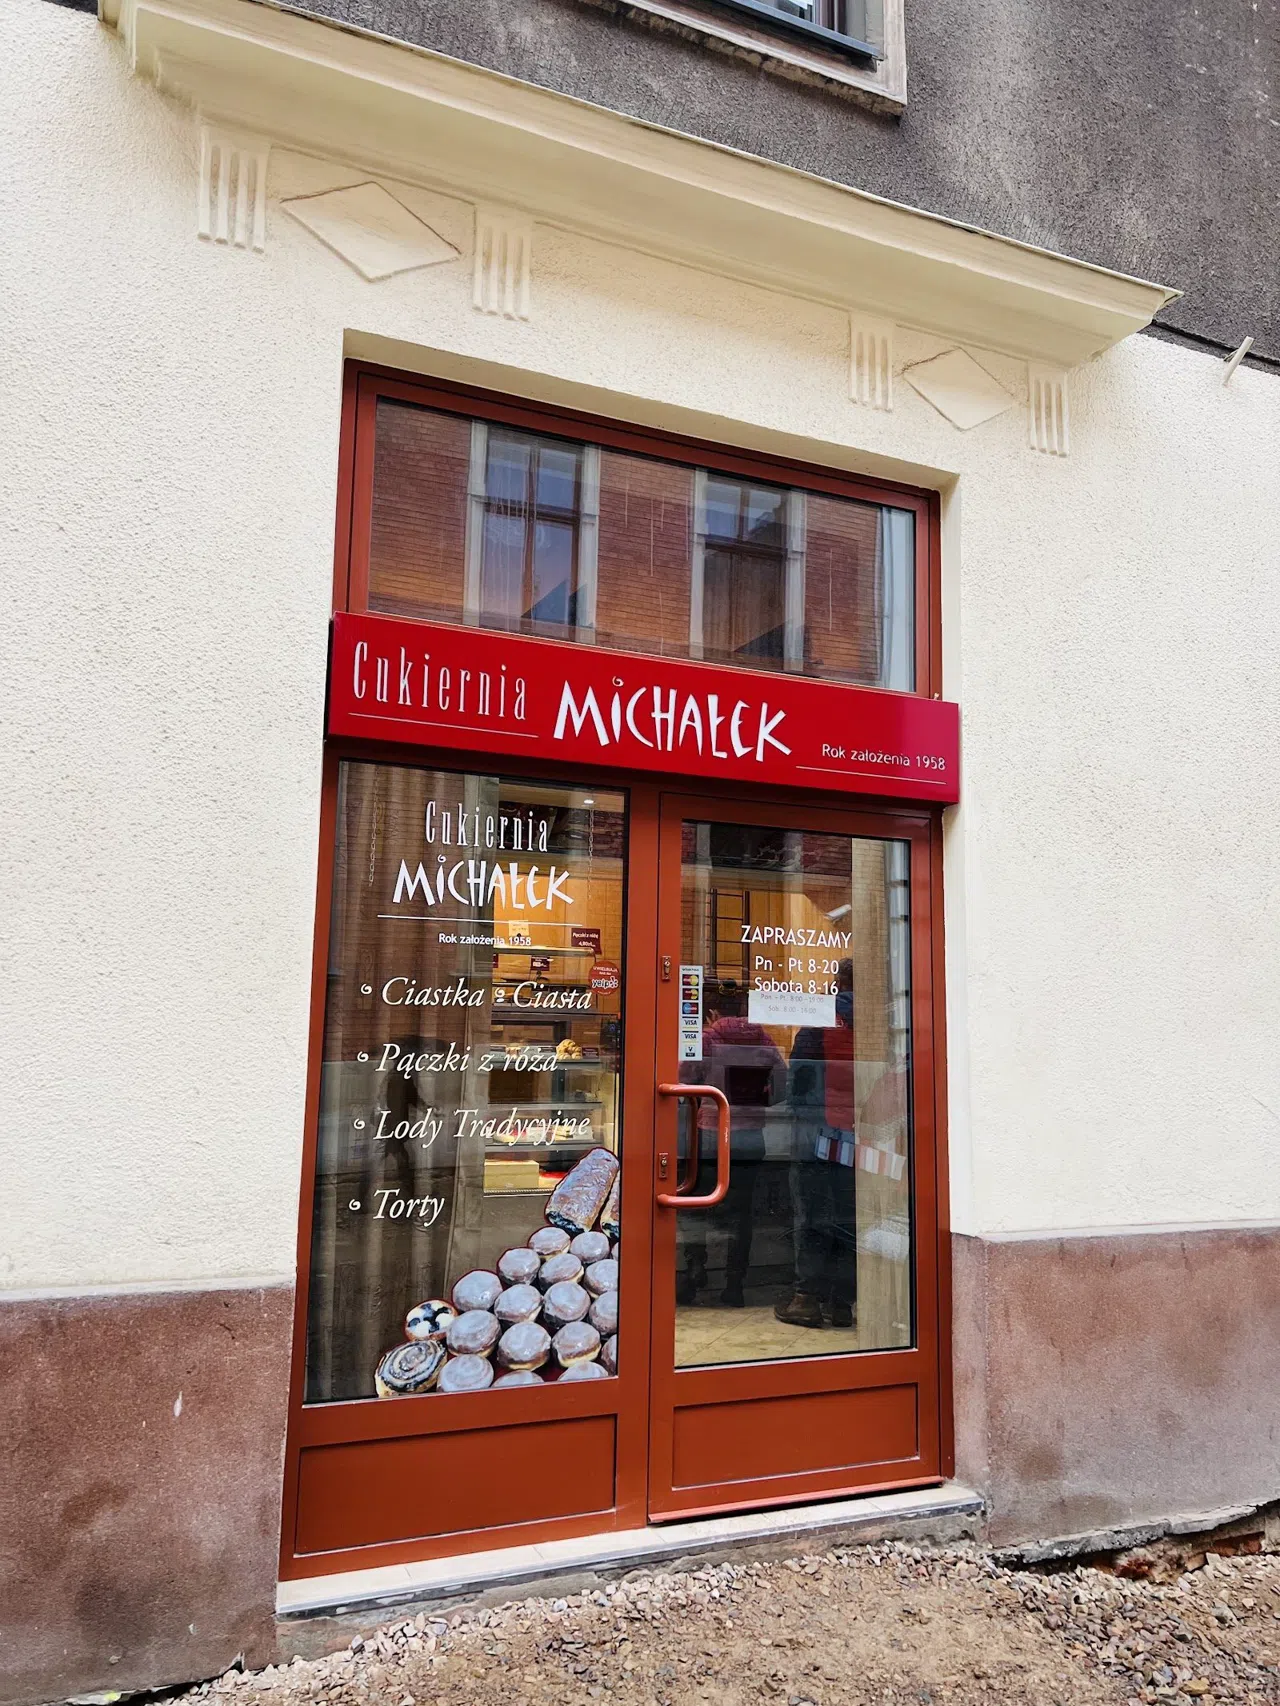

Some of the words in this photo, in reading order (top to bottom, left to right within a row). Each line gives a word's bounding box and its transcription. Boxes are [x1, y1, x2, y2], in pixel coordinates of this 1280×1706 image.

[353, 640, 526, 721] Cukiernia
[822, 743, 846, 759] Rok
[850, 749, 910, 767] założenia
[915, 755, 946, 771] 1958
[425, 800, 548, 852] Cukiernia
[438, 933, 458, 944] Rok
[459, 934, 505, 946] założenia
[508, 936, 532, 946] 1958
[740, 924, 852, 949] ZAPRASZAMY
[755, 955, 773, 971] Pn
[788, 957, 803, 973] Pt
[808, 959, 839, 975] 8-20
[382, 976, 485, 1007] Ciastka
[513, 981, 592, 1010] Ciasta
[755, 977, 803, 994] Sobota
[808, 980, 839, 995] 8-16
[375, 1042, 471, 1080] Pączki
[477, 1054, 495, 1072] z
[373, 1108, 444, 1148] Lody
[453, 1108, 591, 1147] Tradycyjne
[373, 1188, 445, 1227] Torty
